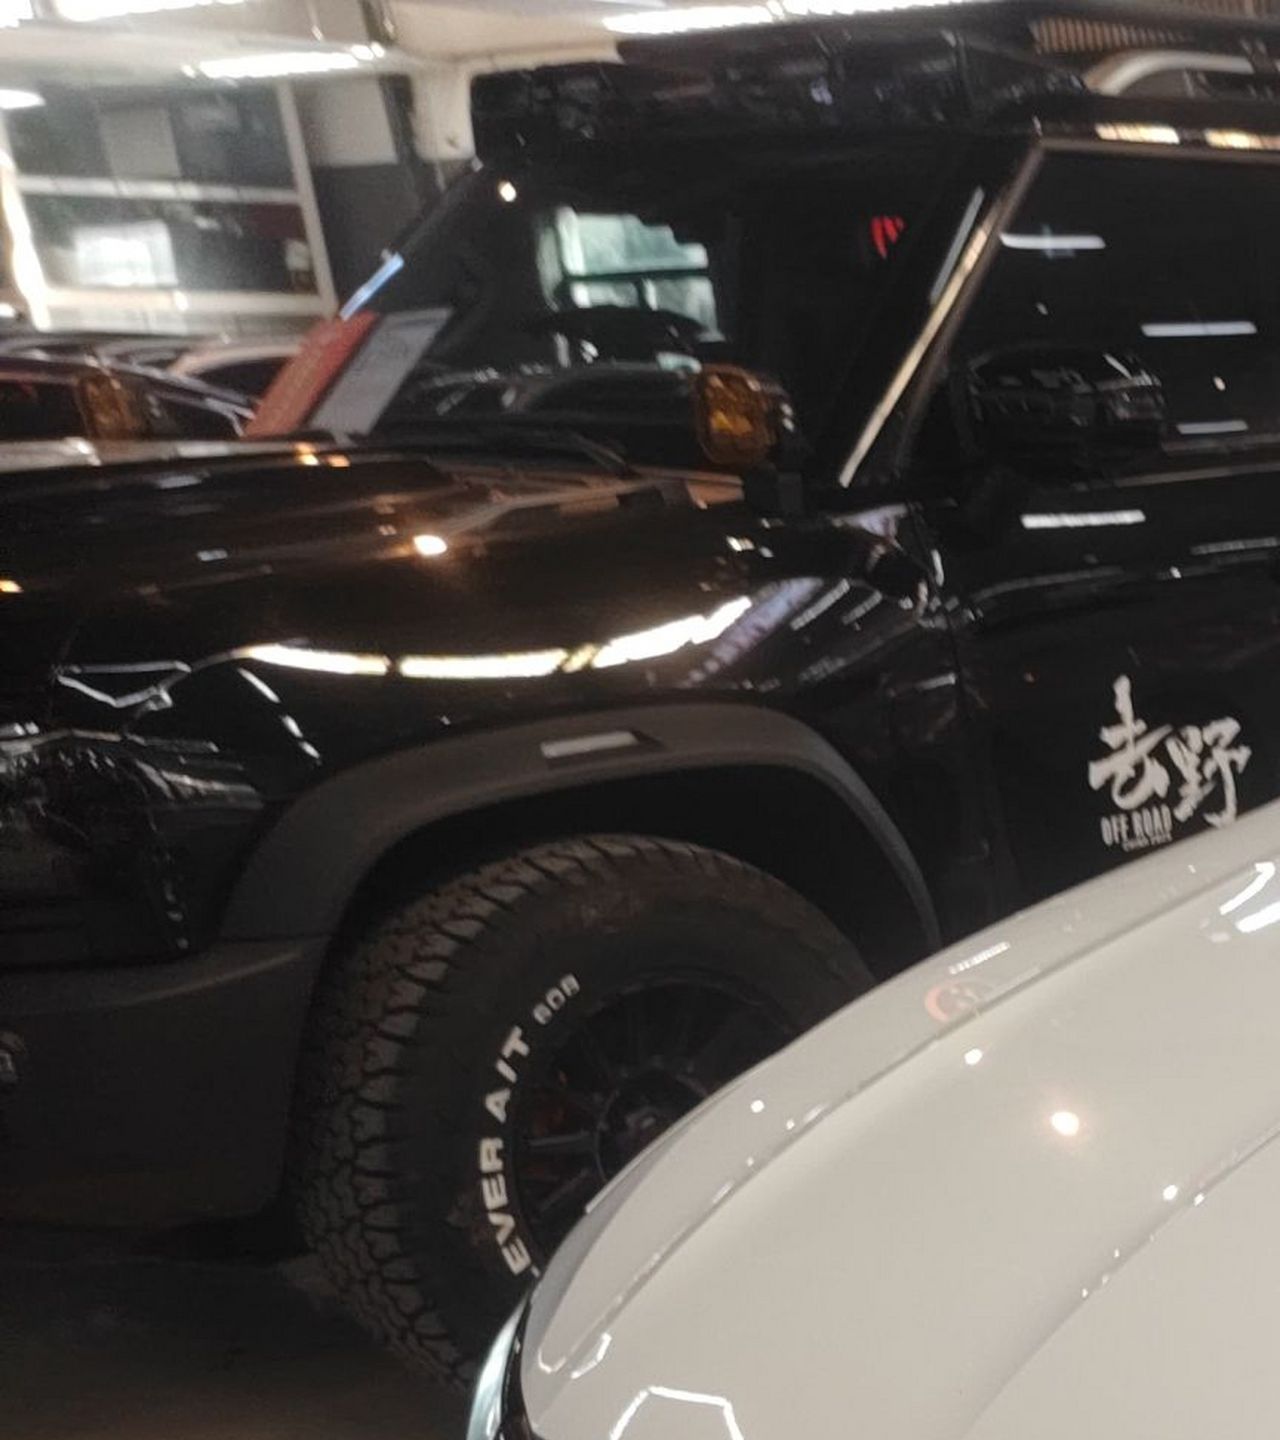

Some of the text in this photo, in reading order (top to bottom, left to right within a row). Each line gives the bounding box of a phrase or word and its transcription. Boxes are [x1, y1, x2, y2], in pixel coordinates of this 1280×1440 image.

[1089, 675, 1252, 829] 去野
[1100, 814, 1130, 847] OFF
[1132, 804, 1173, 839] ROAD
